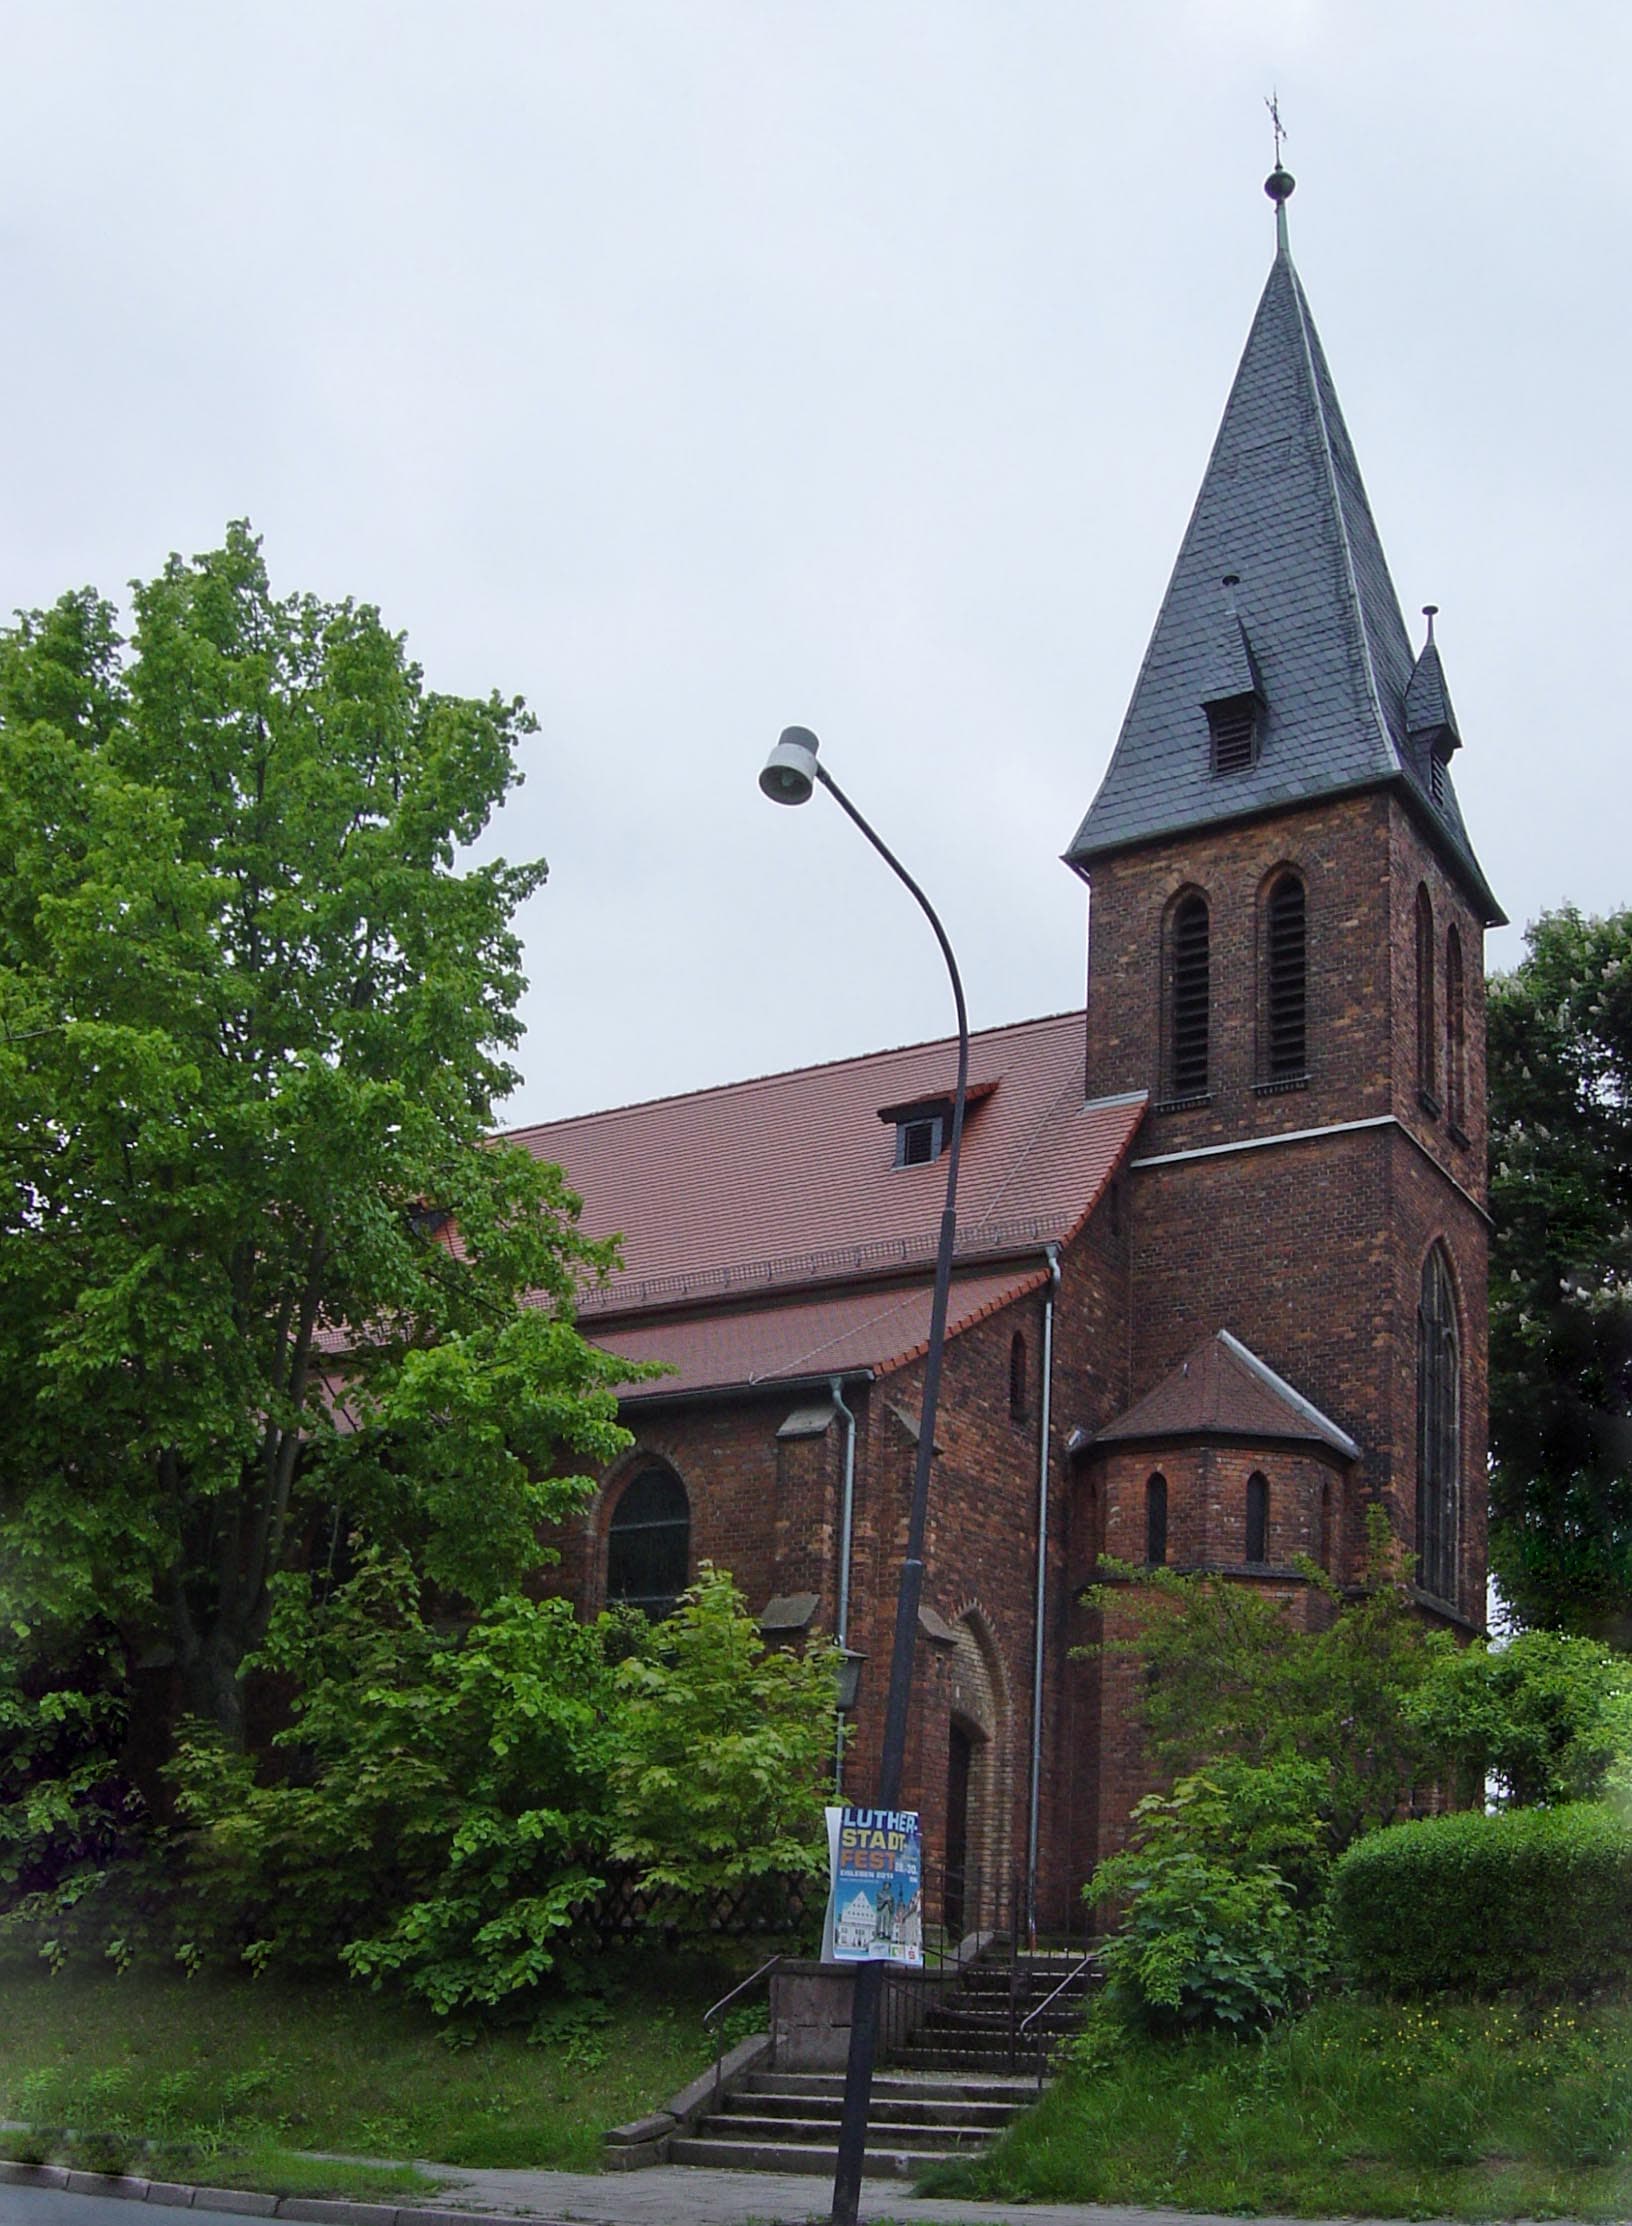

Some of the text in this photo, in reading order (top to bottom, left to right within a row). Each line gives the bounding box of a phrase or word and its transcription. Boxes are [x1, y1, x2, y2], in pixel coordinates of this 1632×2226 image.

[843, 1808, 918, 1834] LUTHER-
[842, 1829, 908, 1851] STADT-
[841, 1849, 896, 1872] FEST
[840, 1870, 874, 1878] EISLEBEN
